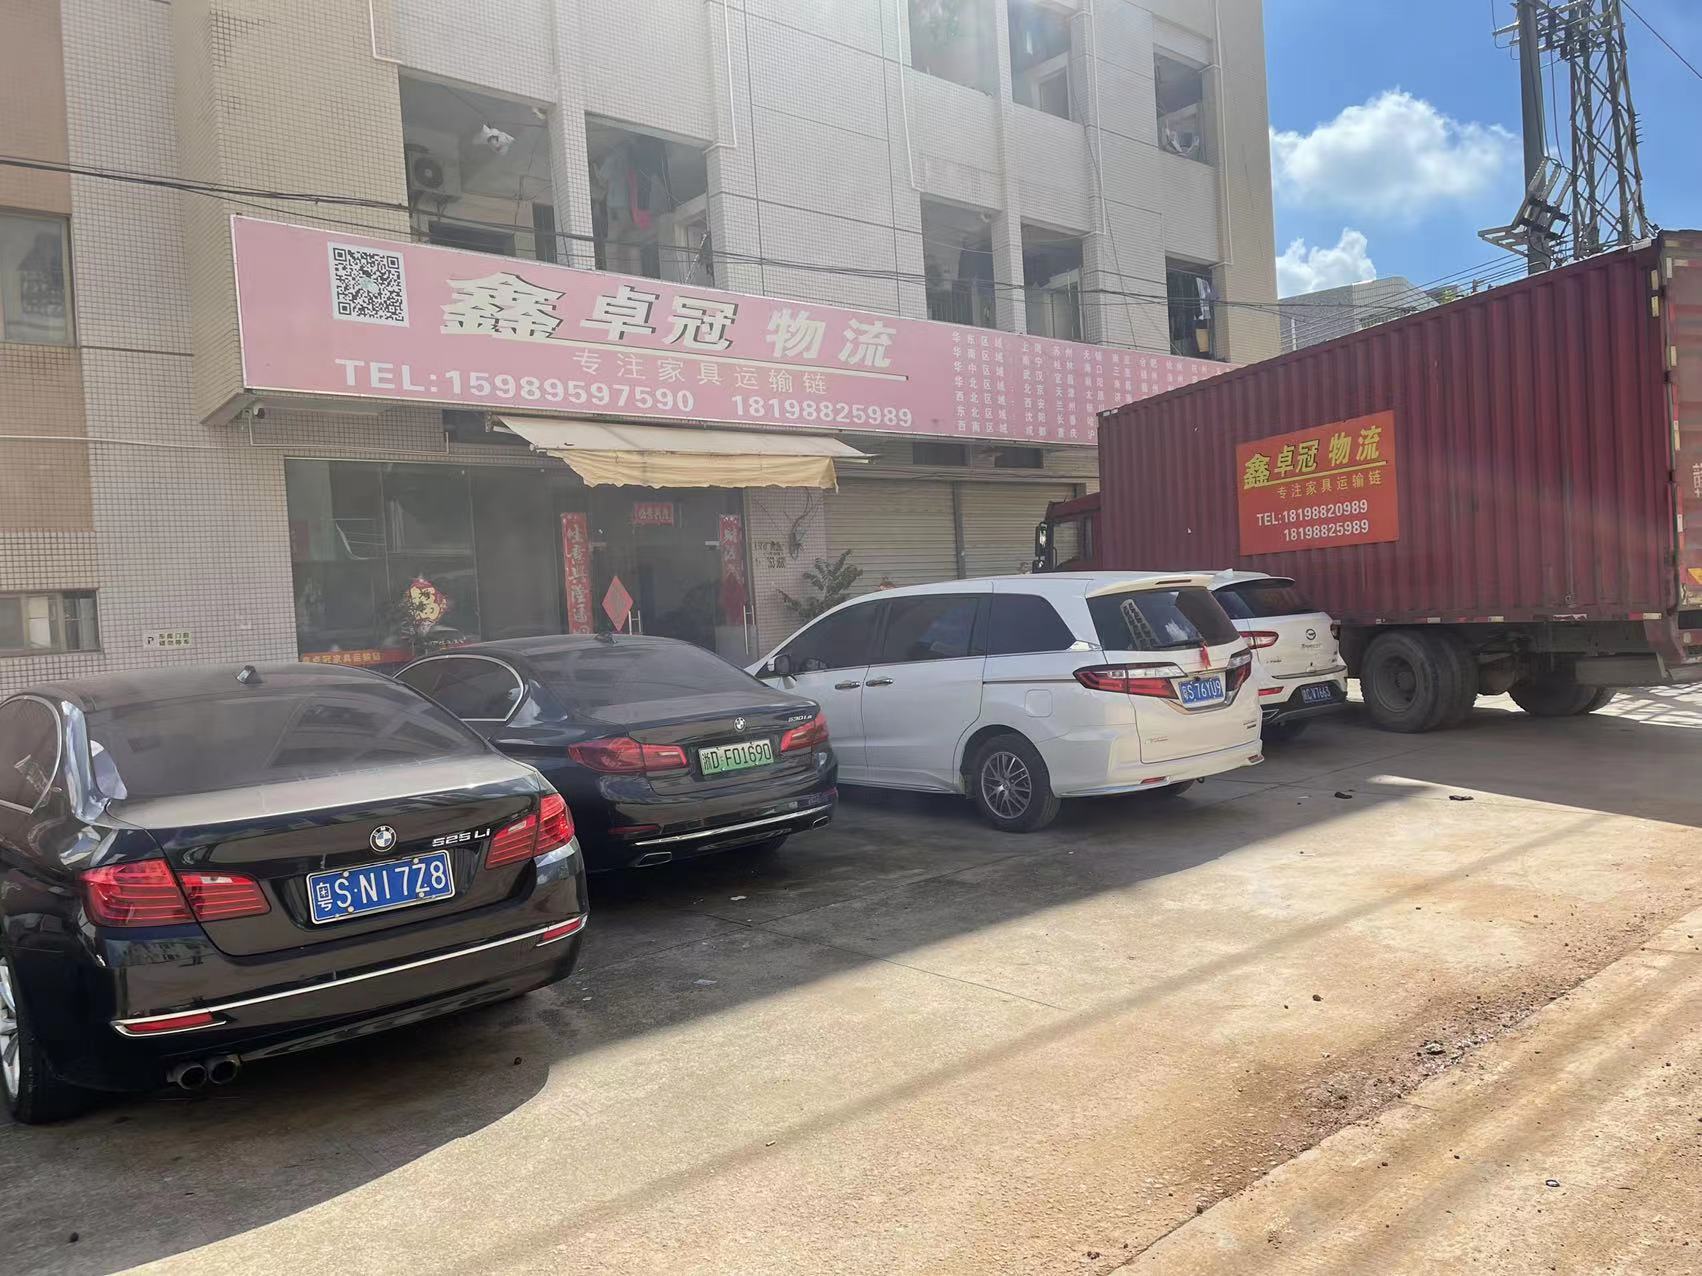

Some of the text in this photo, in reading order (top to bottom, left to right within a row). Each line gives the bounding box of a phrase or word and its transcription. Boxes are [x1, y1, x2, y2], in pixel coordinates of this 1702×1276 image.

[572, 348, 828, 396] 专注家具运输链
[731, 394, 914, 428] 18198825989
[1277, 470, 1382, 499] 专注家具运输链
[1284, 519, 1369, 541] 18198825989
